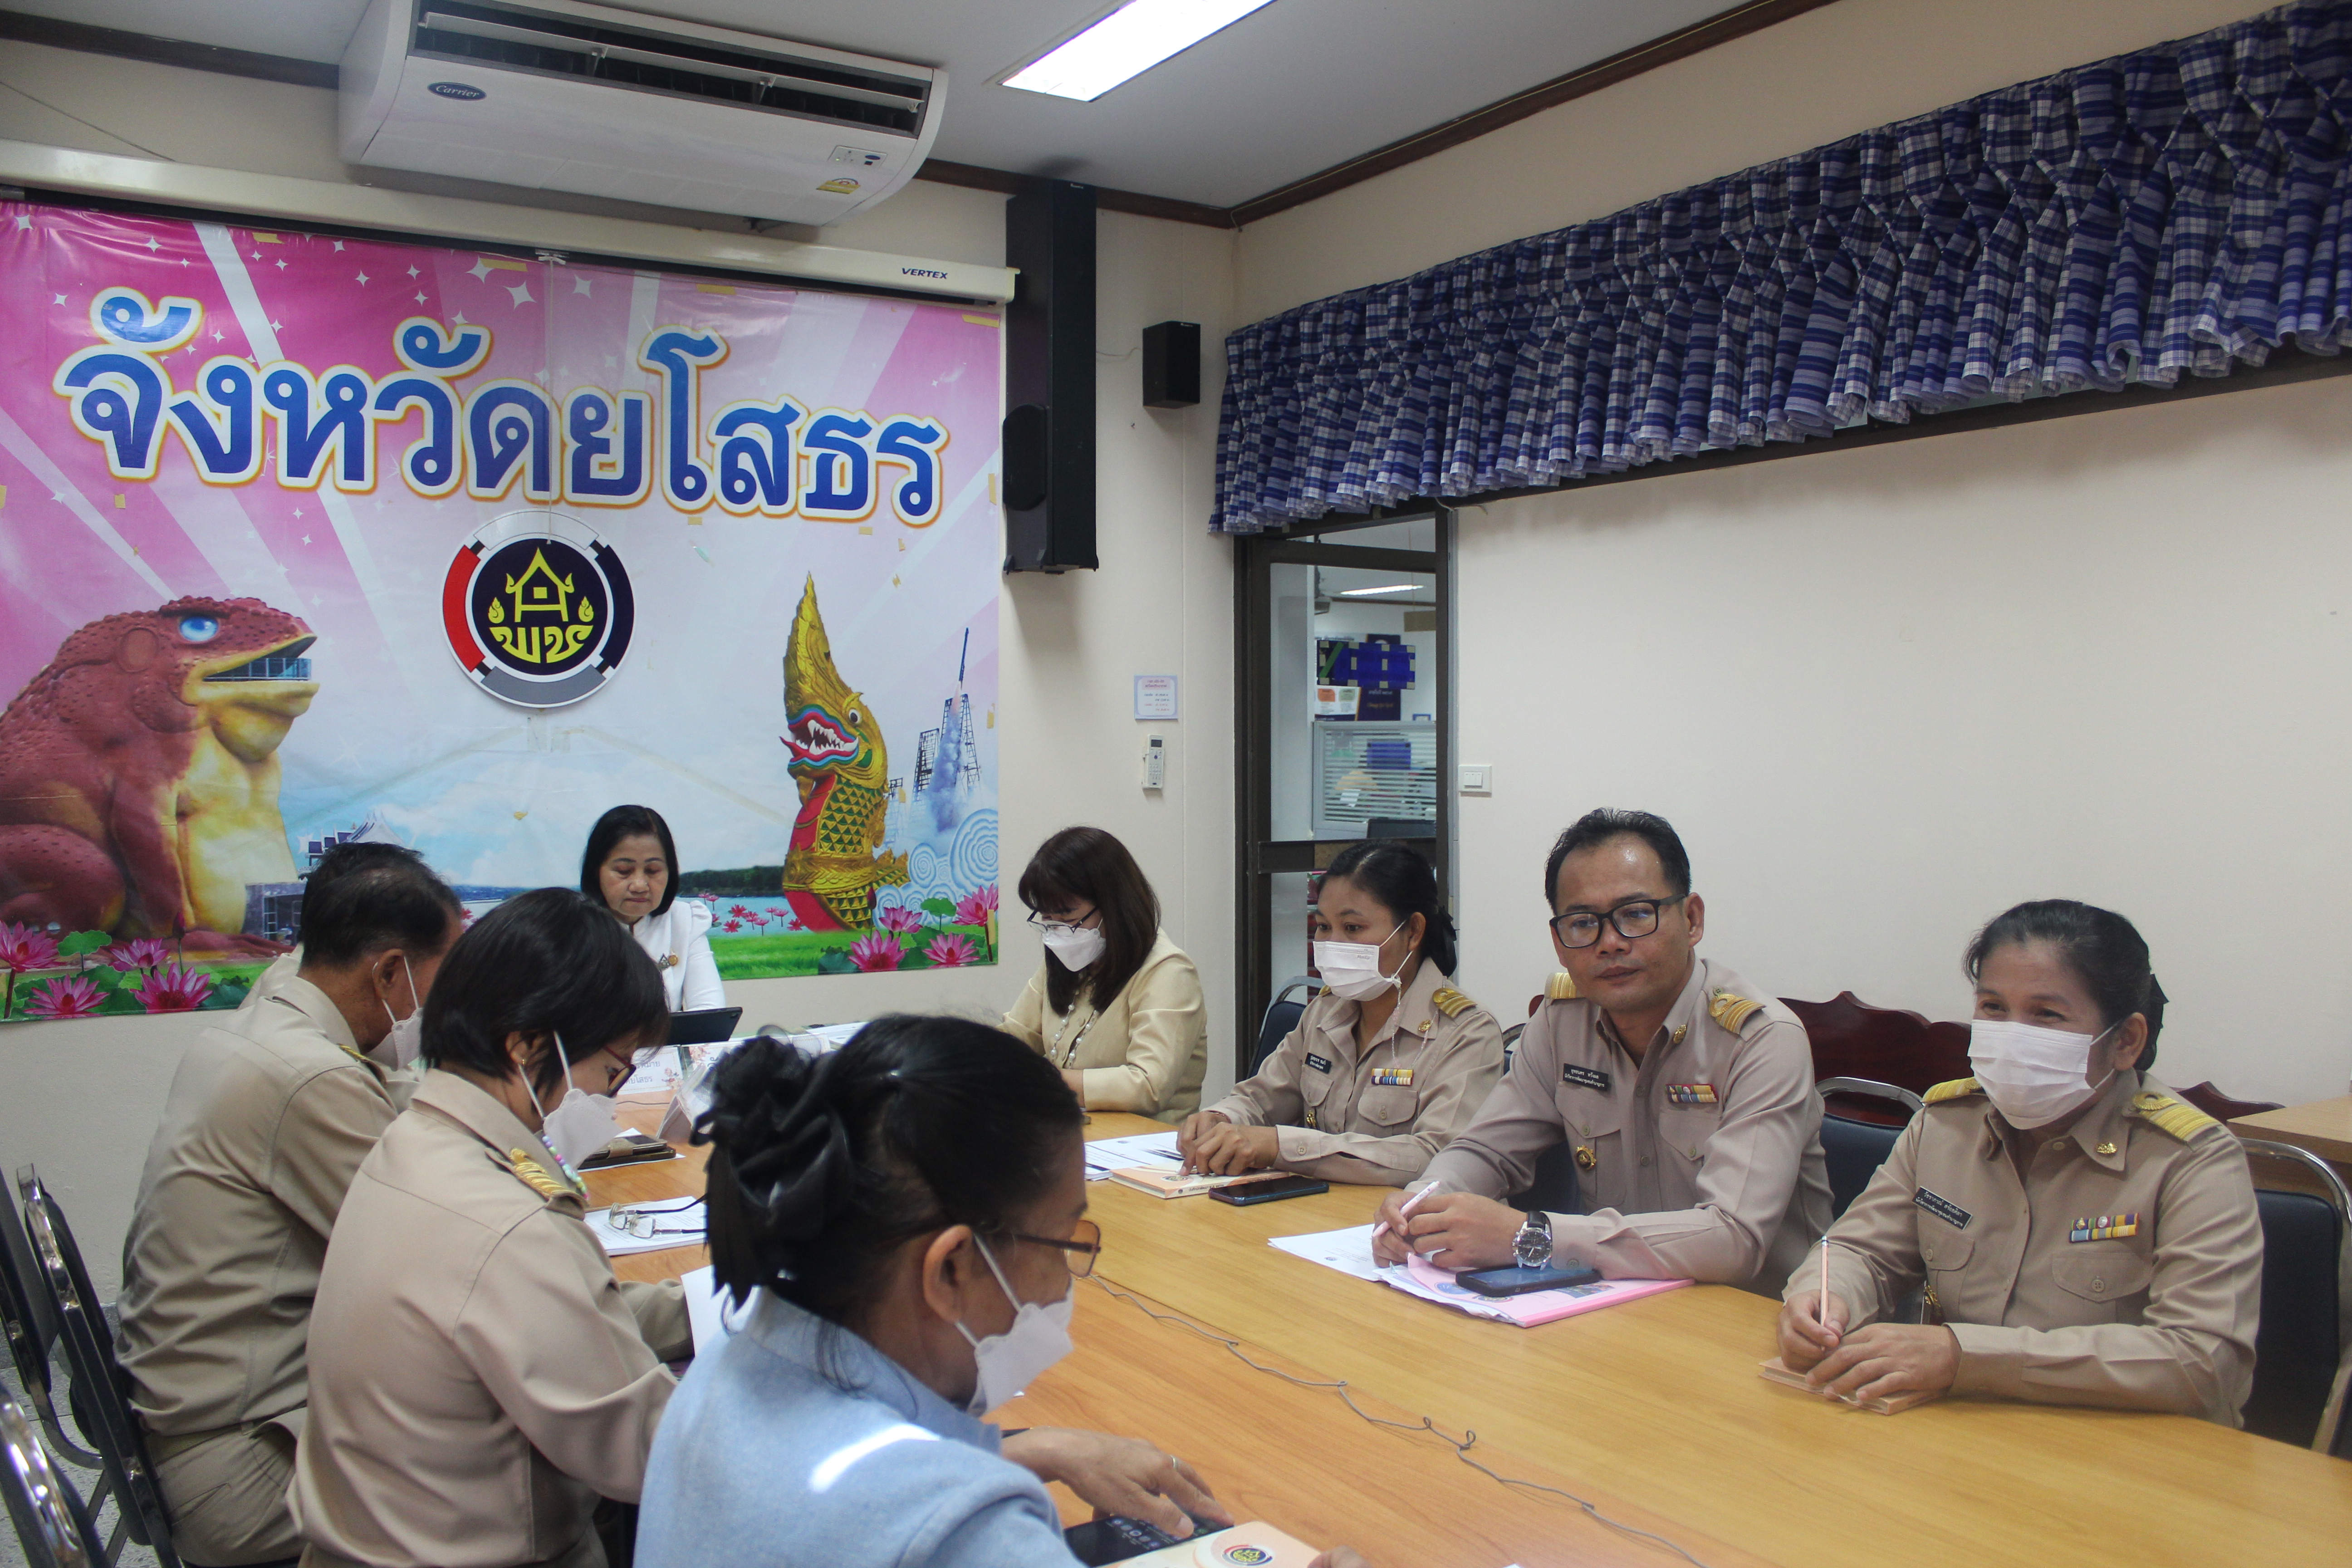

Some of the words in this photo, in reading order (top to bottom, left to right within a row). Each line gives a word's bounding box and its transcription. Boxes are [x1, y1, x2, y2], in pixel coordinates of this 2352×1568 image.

[436, 85, 480, 97] Carrier
[902, 268, 948, 279] VERTEX
[61, 292, 946, 521] จังหวัดยโสธร
